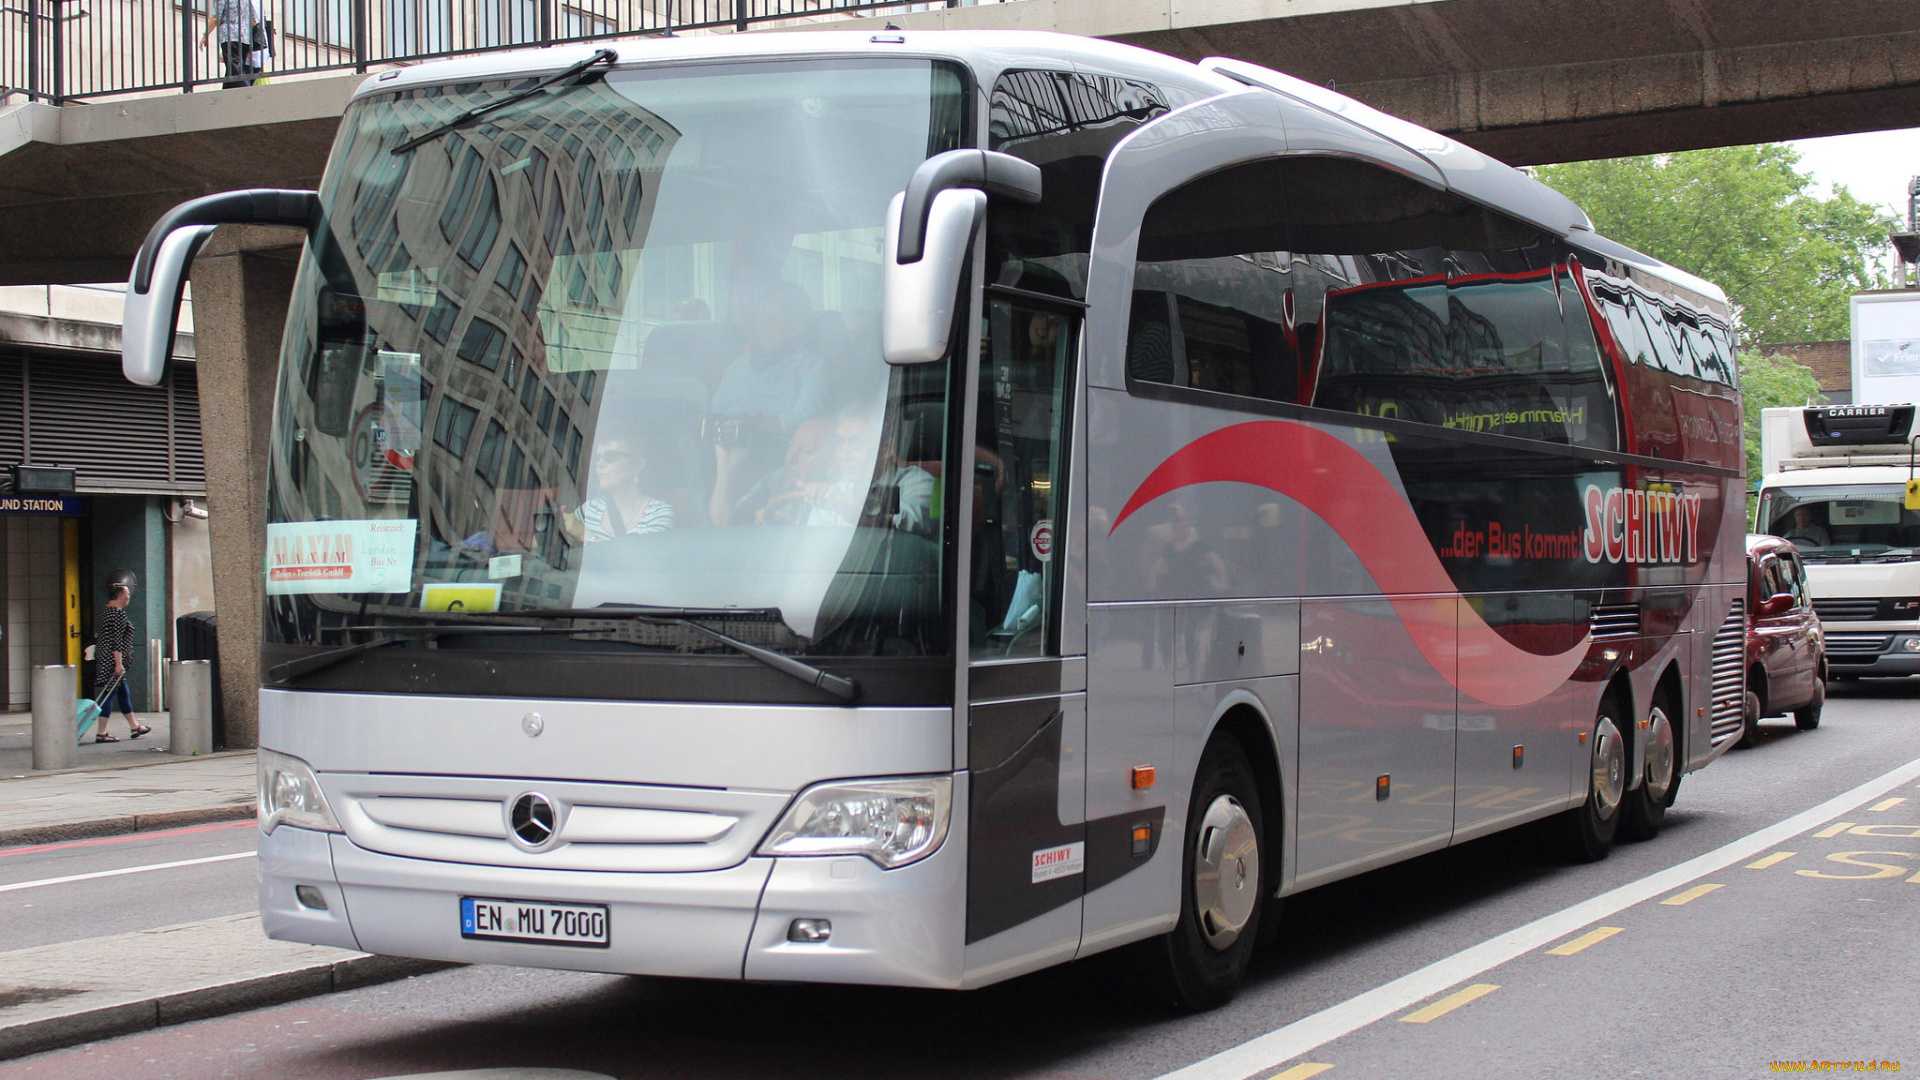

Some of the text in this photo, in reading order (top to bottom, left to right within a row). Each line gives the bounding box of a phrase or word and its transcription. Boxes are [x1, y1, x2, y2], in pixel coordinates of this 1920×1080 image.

[1829, 408, 1885, 416] CARRIER
[22, 499, 63, 511] STATION
[1584, 484, 1699, 563] SCHIWY
[1488, 521, 1521, 559] Bus
[1525, 524, 1583, 559] kommt!
[276, 552, 346, 565] MAXIM
[371, 557, 385, 566] Bus
[1035, 848, 1071, 867] SCHIWY
[476, 904, 604, 938] EN MU 7000
